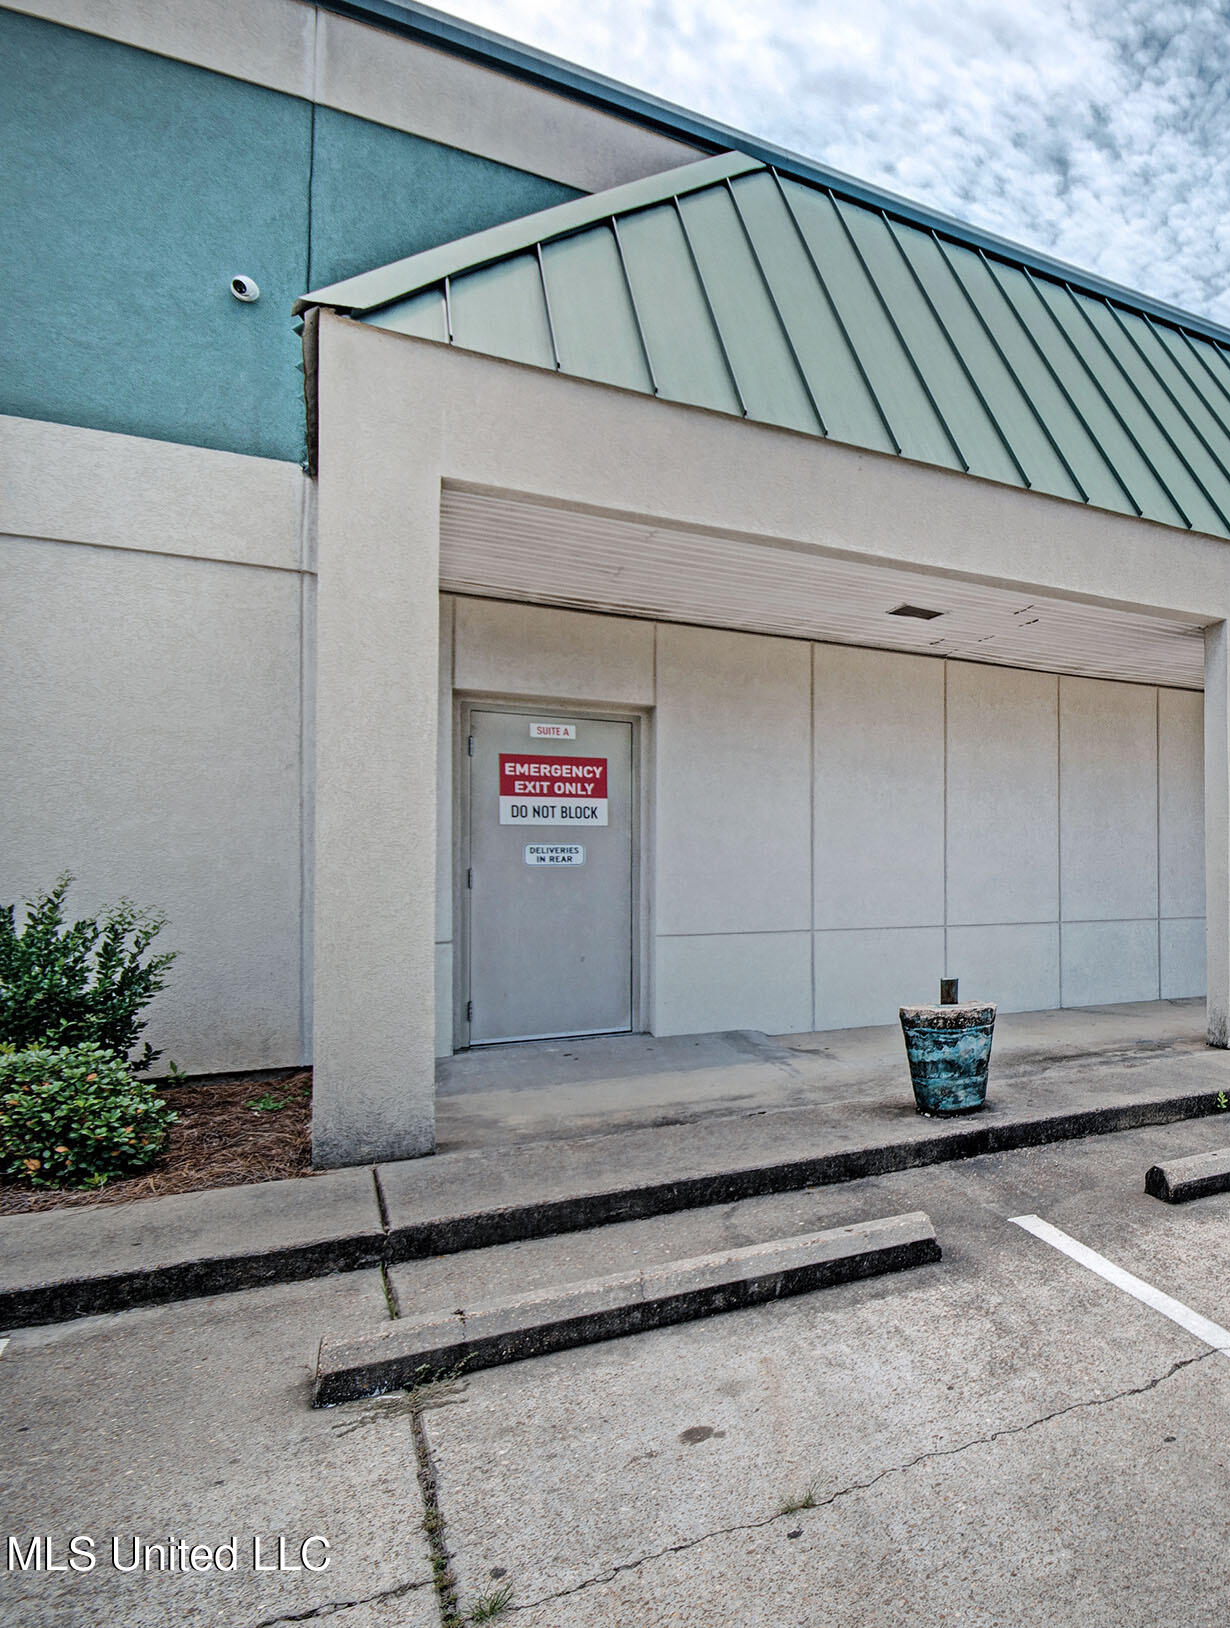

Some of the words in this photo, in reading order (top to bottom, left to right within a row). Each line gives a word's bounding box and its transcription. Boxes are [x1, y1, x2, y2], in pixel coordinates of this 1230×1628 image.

[536, 726, 561, 736] SUITE
[563, 728, 570, 737] A
[504, 762, 603, 778] EMERGENCY
[514, 781, 551, 794] EXIT
[553, 782, 595, 795] ONLY
[511, 805, 528, 818] DO
[532, 805, 556, 818] NOT
[560, 806, 598, 819] BLOCK
